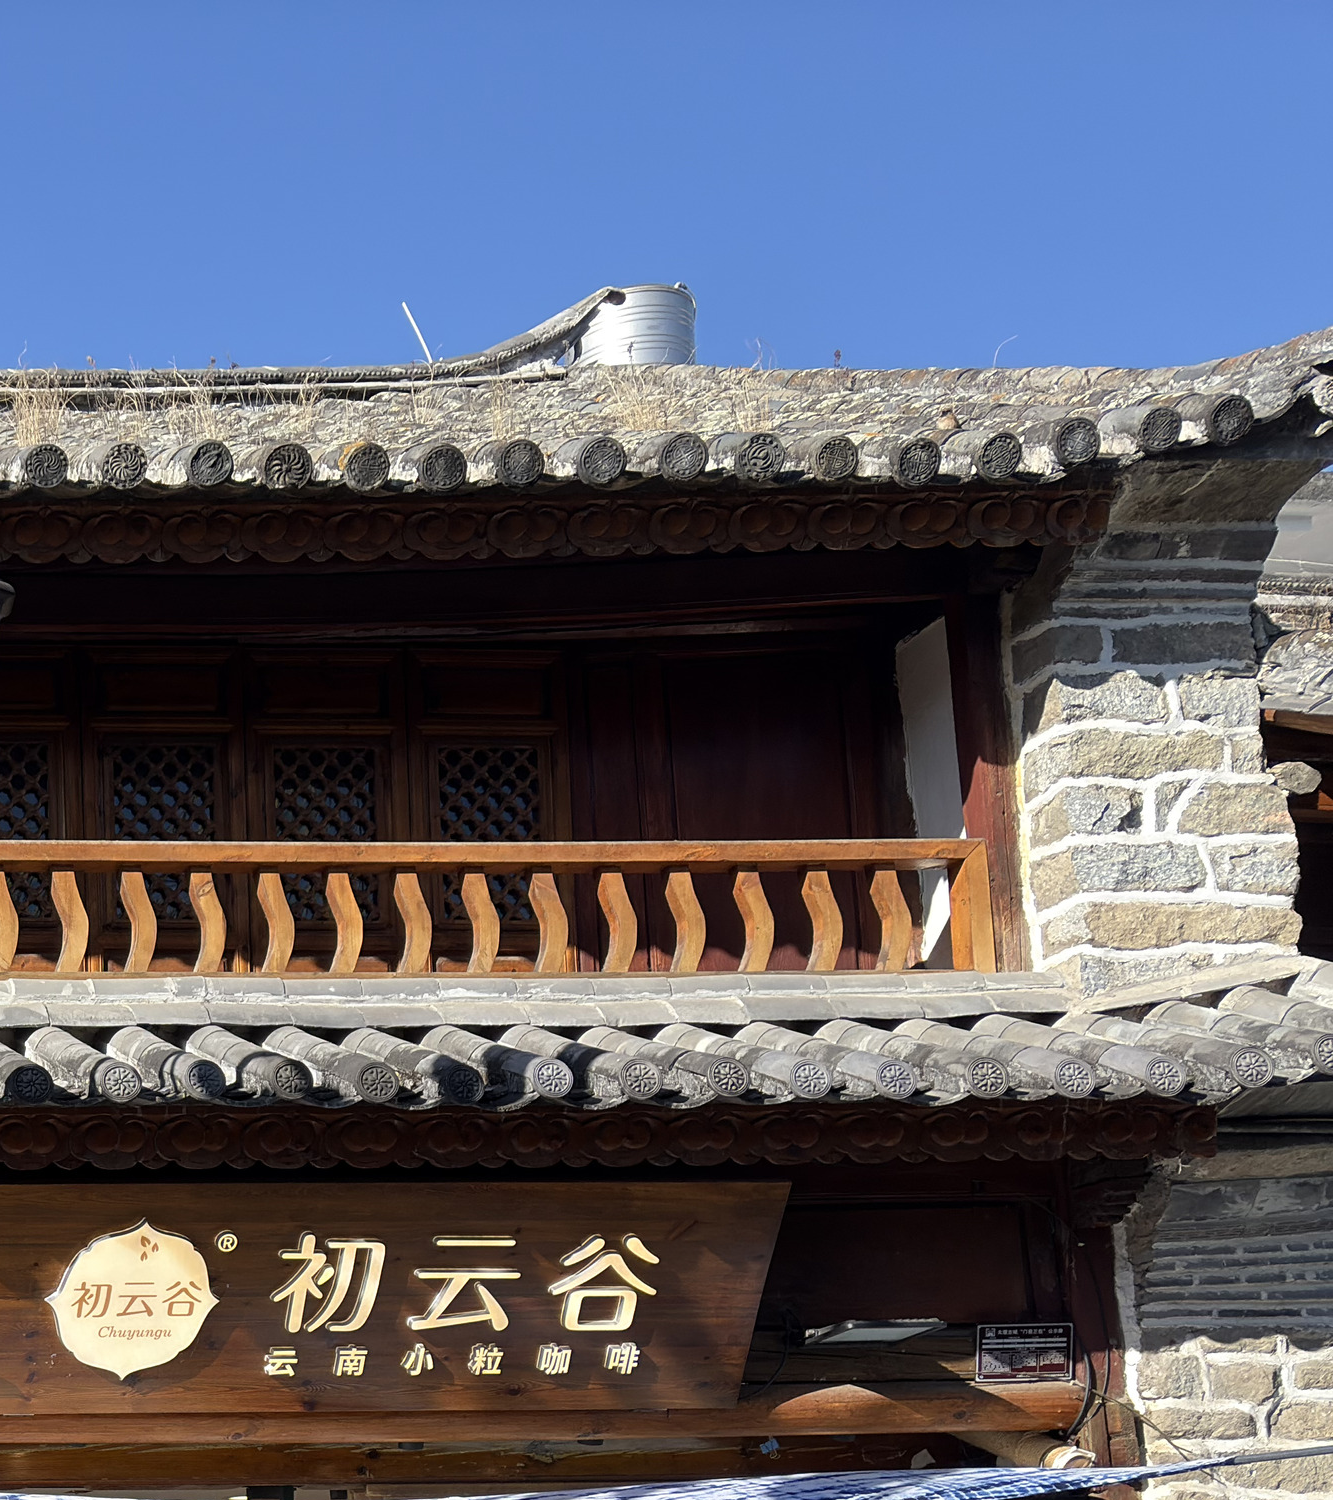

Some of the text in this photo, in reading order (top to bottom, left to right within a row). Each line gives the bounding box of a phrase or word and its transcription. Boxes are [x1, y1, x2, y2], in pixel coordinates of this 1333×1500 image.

[71, 1279, 203, 1320] 初云谷
[269, 1229, 661, 1333] 初云谷
[98, 1325, 173, 1341] Chuyungu
[263, 1343, 641, 1378] 云南小粒咖啡
